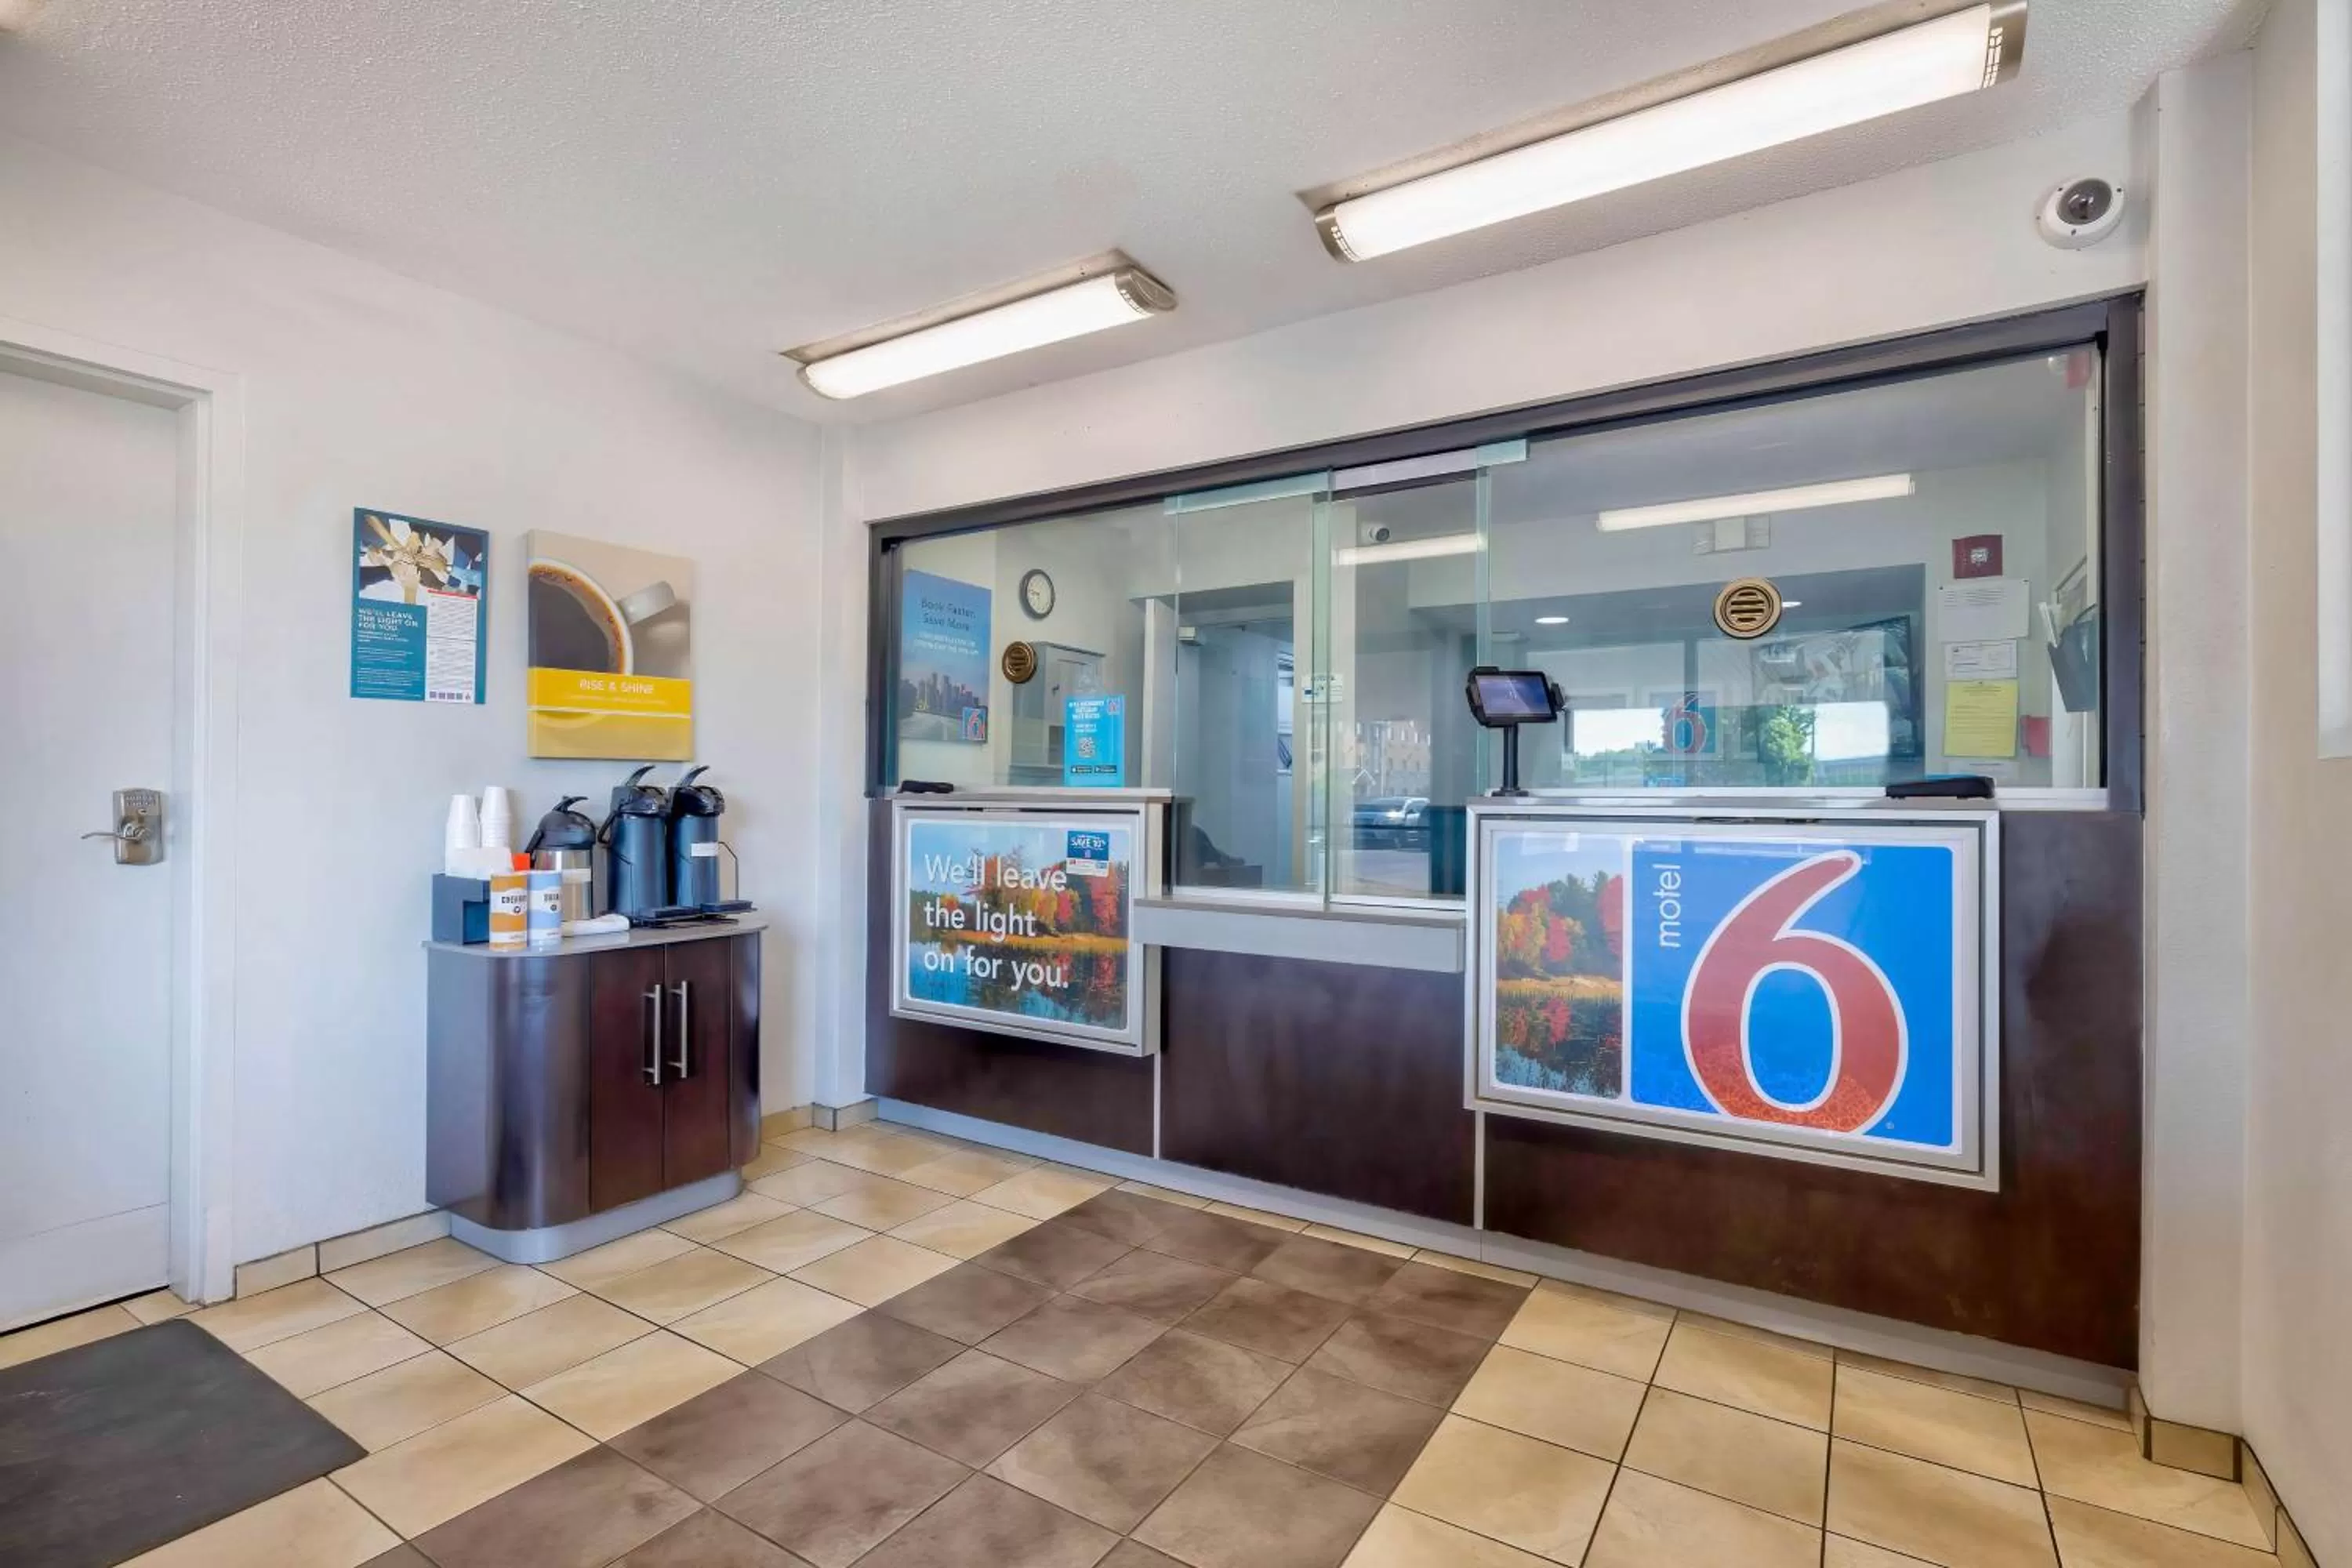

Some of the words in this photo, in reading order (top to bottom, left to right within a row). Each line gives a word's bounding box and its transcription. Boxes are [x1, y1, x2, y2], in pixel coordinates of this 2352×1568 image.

[579, 678, 604, 691] RISE
[621, 681, 653, 694] SHINE
[924, 853, 985, 886] We'll
[996, 855, 1067, 892] leave
[924, 897, 965, 929] the
[976, 900, 1036, 942] light
[1653, 863, 1681, 948] motel
[924, 950, 954, 973] on
[965, 945, 1003, 979] for
[1011, 960, 1069, 991] you.
[1680, 849, 1908, 1135] 6
